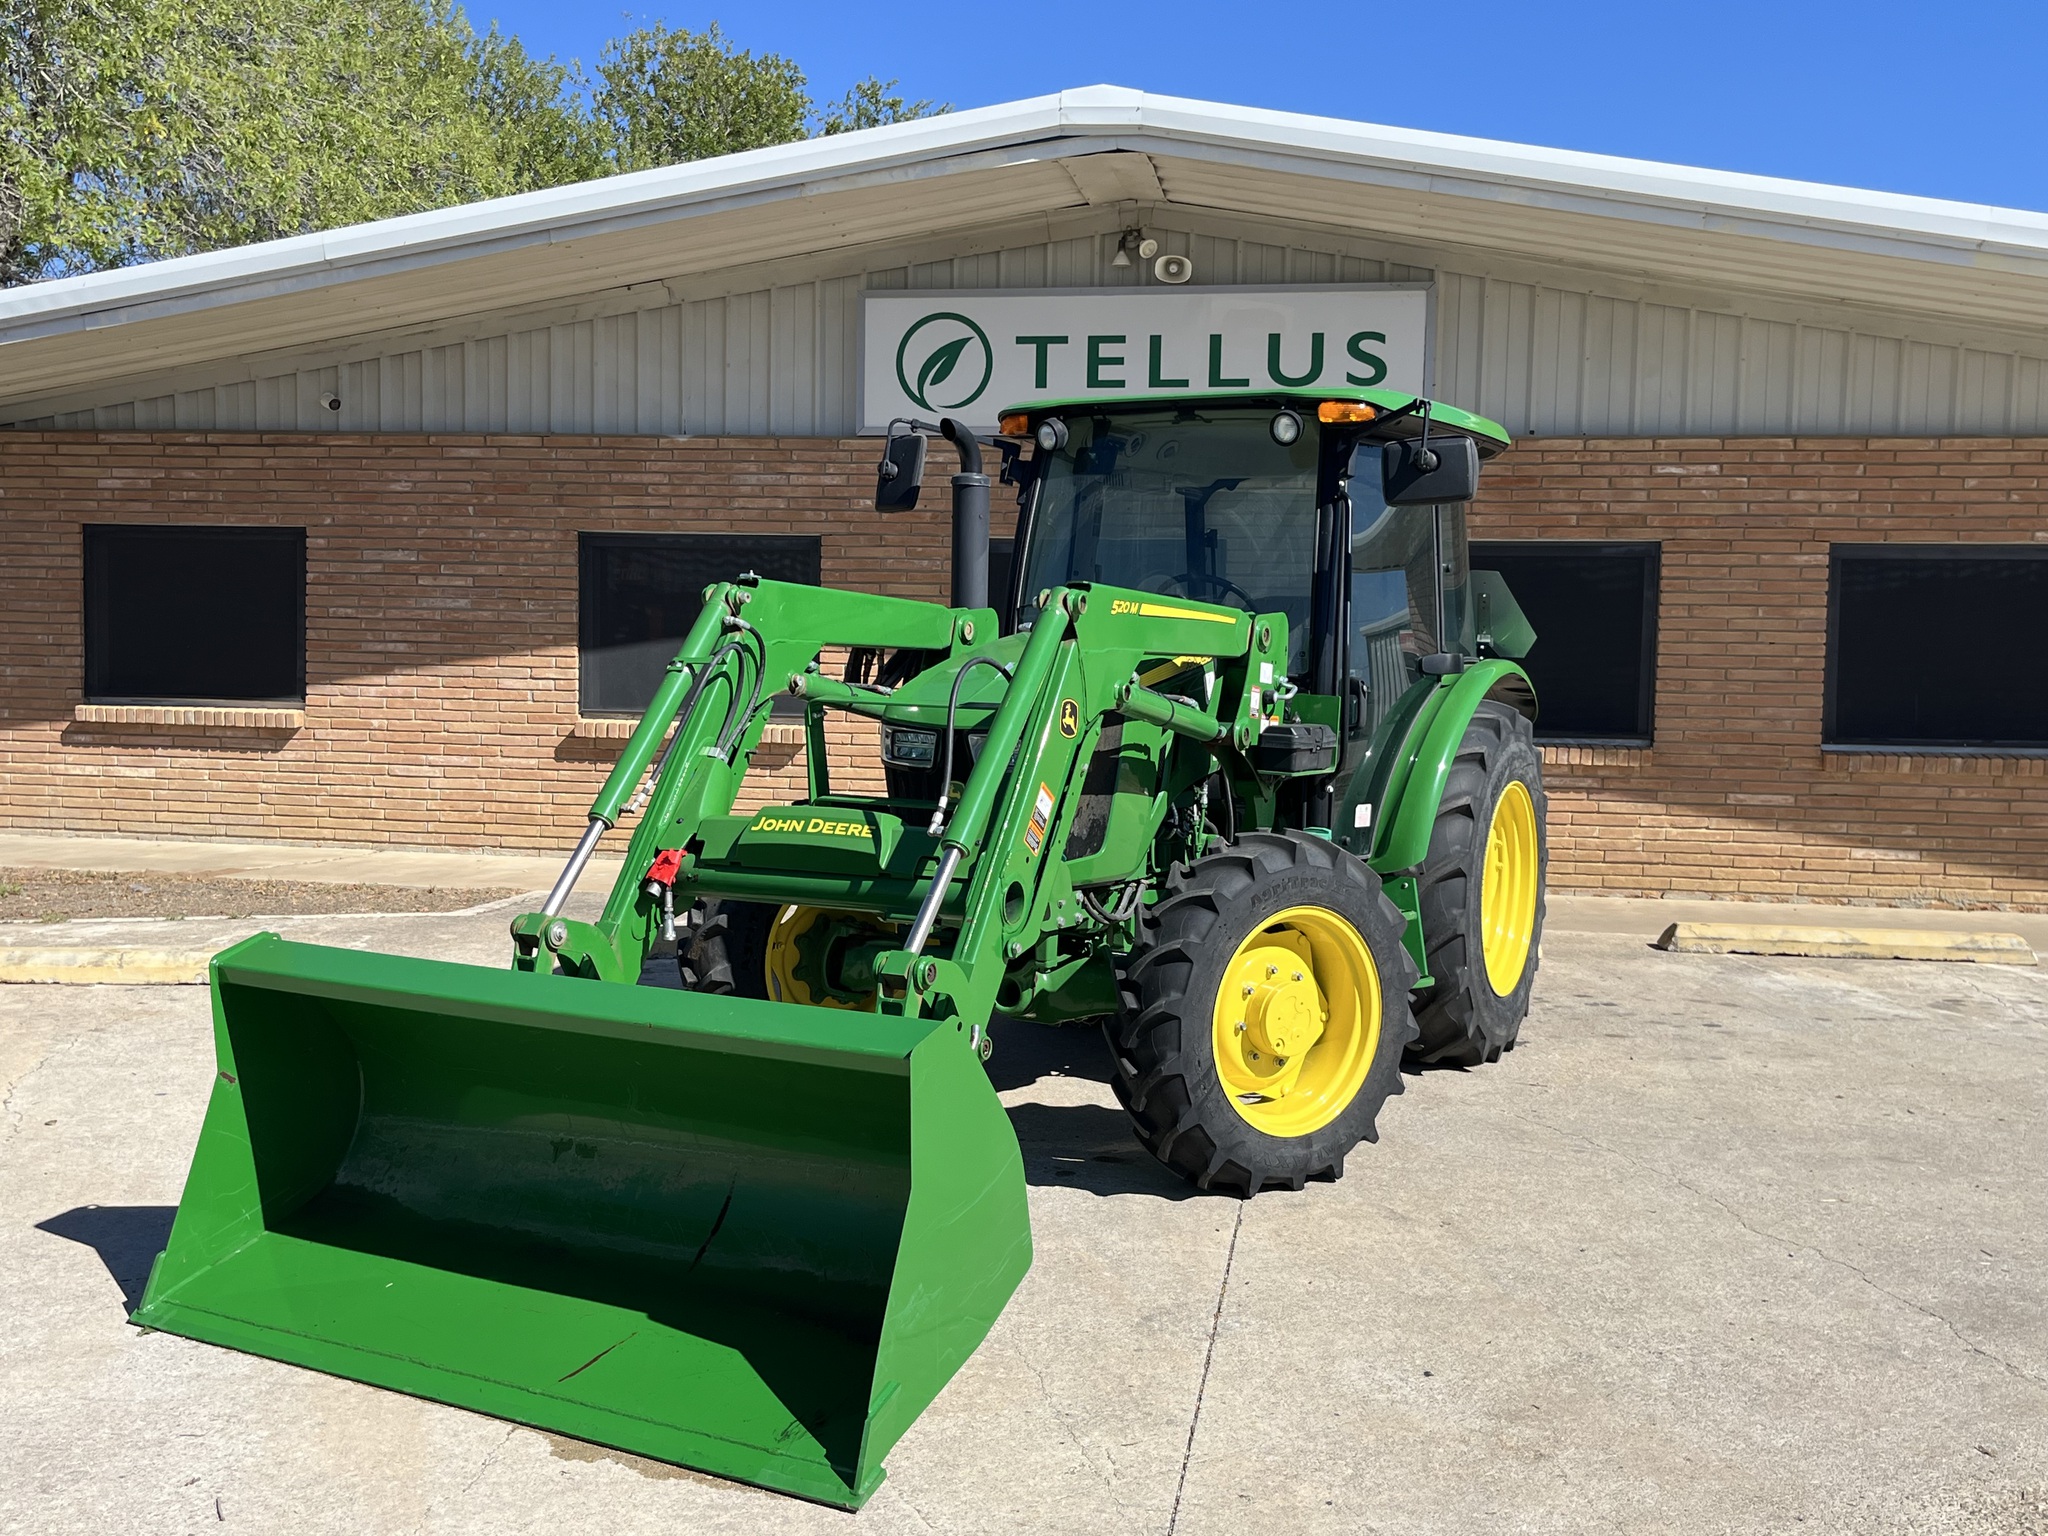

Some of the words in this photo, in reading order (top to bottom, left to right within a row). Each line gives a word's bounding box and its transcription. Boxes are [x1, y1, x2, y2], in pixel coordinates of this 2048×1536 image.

[1016, 331, 1388, 388] TELLUS
[751, 817, 805, 832] JOHN
[808, 819, 873, 837] DEERE
